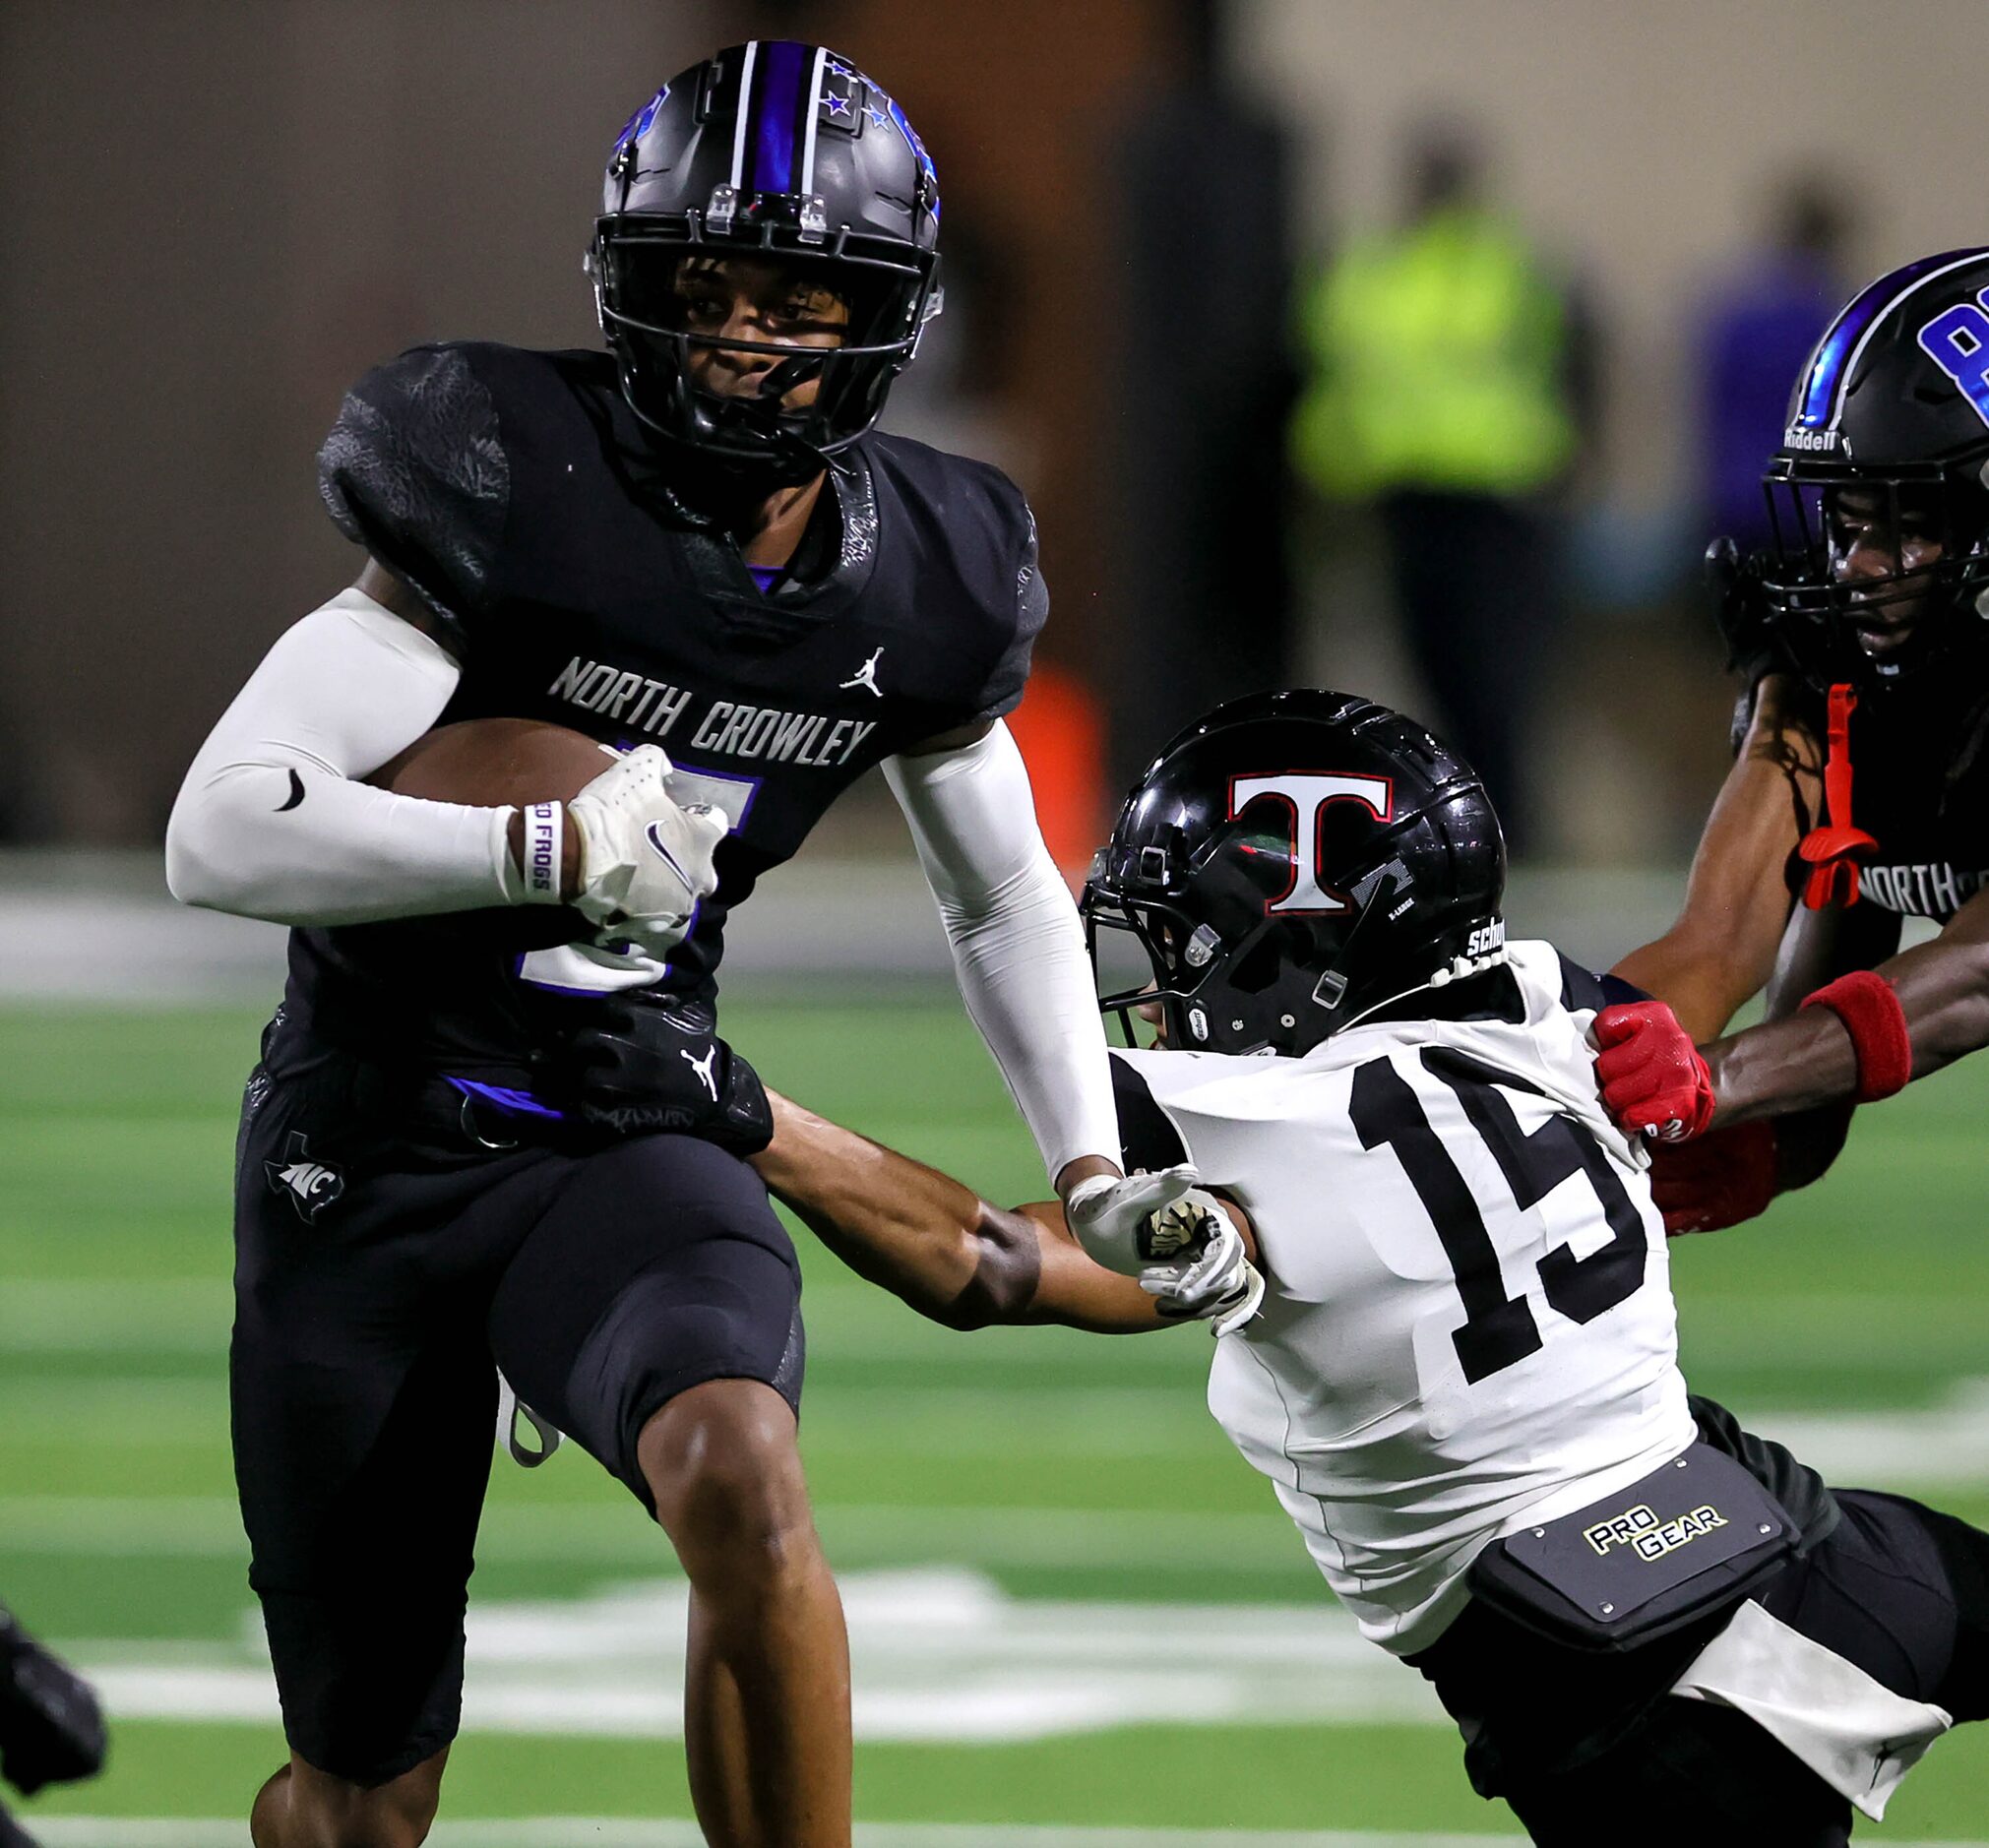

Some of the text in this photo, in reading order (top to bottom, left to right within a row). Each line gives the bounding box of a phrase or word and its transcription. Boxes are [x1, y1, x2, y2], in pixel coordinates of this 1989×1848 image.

[1783, 429, 1836, 451] Riddell
[547, 656, 878, 766] NORTH CROWLEY
[533, 825, 553, 891] FROGS
[1228, 770, 1395, 917] T
[1348, 1046, 1648, 1386] 15
[1583, 1505, 1660, 1557] PRO
[1632, 1505, 1729, 1563] GEAR
